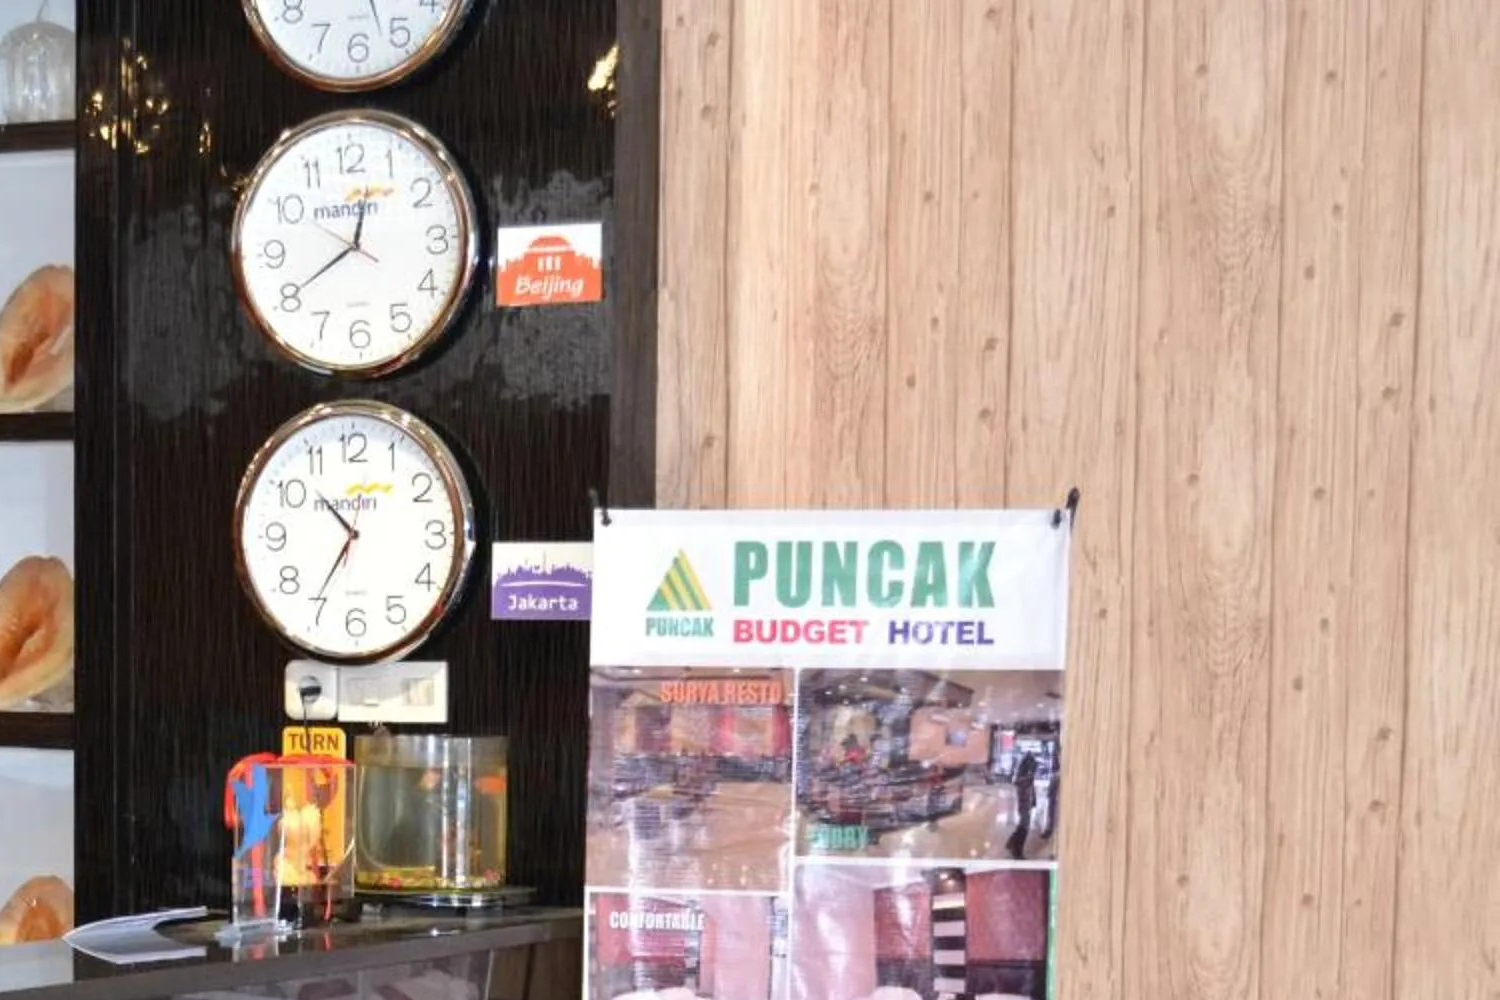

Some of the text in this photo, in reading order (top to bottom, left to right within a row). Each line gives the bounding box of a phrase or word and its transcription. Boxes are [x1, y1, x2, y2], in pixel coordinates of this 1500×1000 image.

[311, 23, 331, 53] 7
[389, 17, 411, 48] 5
[347, 33, 370, 63] 6
[336, 143, 365, 175] 12
[385, 149, 394, 178] 1
[303, 159, 321, 190] 11
[410, 178, 434, 209] 2
[276, 193, 305, 225] 10
[313, 199, 379, 219] mandri
[263, 240, 286, 270] 9
[425, 225, 450, 256] 3
[280, 283, 301, 312] 8
[417, 268, 440, 299] 4
[514, 276, 584, 297] Beijing
[311, 310, 331, 341] 7
[389, 303, 412, 333] 5
[350, 319, 371, 349] 6
[307, 446, 323, 476] 11
[339, 433, 368, 463] 12
[387, 441, 396, 471] 1
[277, 479, 306, 508] 10
[314, 493, 377, 511] mandiri
[411, 473, 433, 502] 2
[265, 522, 287, 551] 9
[424, 520, 447, 549] 3
[279, 565, 300, 595] 8
[414, 562, 437, 592] 4
[733, 540, 997, 609] PUNCAK
[308, 597, 327, 627] 7
[386, 595, 407, 625] 5
[507, 594, 579, 612] Jakarta
[345, 608, 367, 638] 6
[645, 616, 714, 637] PUNCAK
[733, 619, 995, 645] BUDGET HOTEL
[660, 680, 782, 705] SURYA RESTO
[287, 732, 339, 751] TURN
